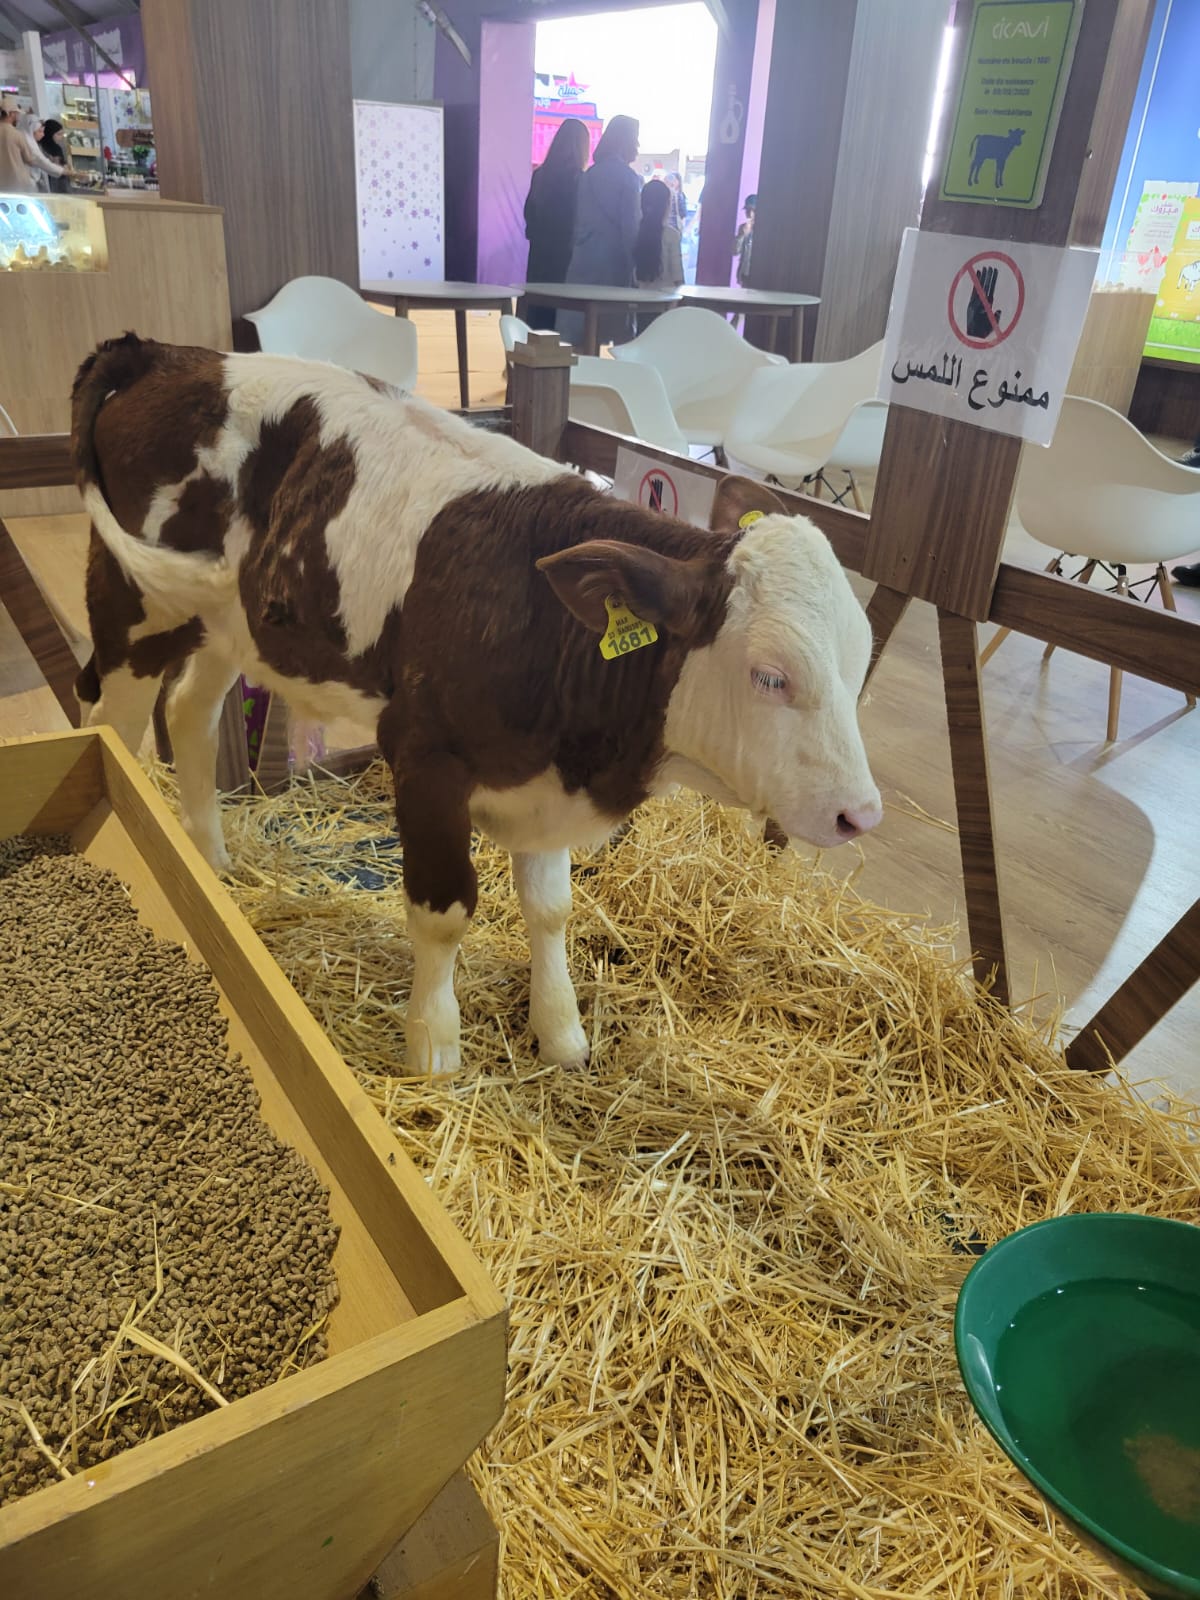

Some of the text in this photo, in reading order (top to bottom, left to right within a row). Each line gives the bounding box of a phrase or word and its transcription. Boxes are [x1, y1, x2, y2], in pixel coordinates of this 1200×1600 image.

[891, 352, 1050, 410] ممنوع اللمس
[608, 626, 653, 655] 1681
